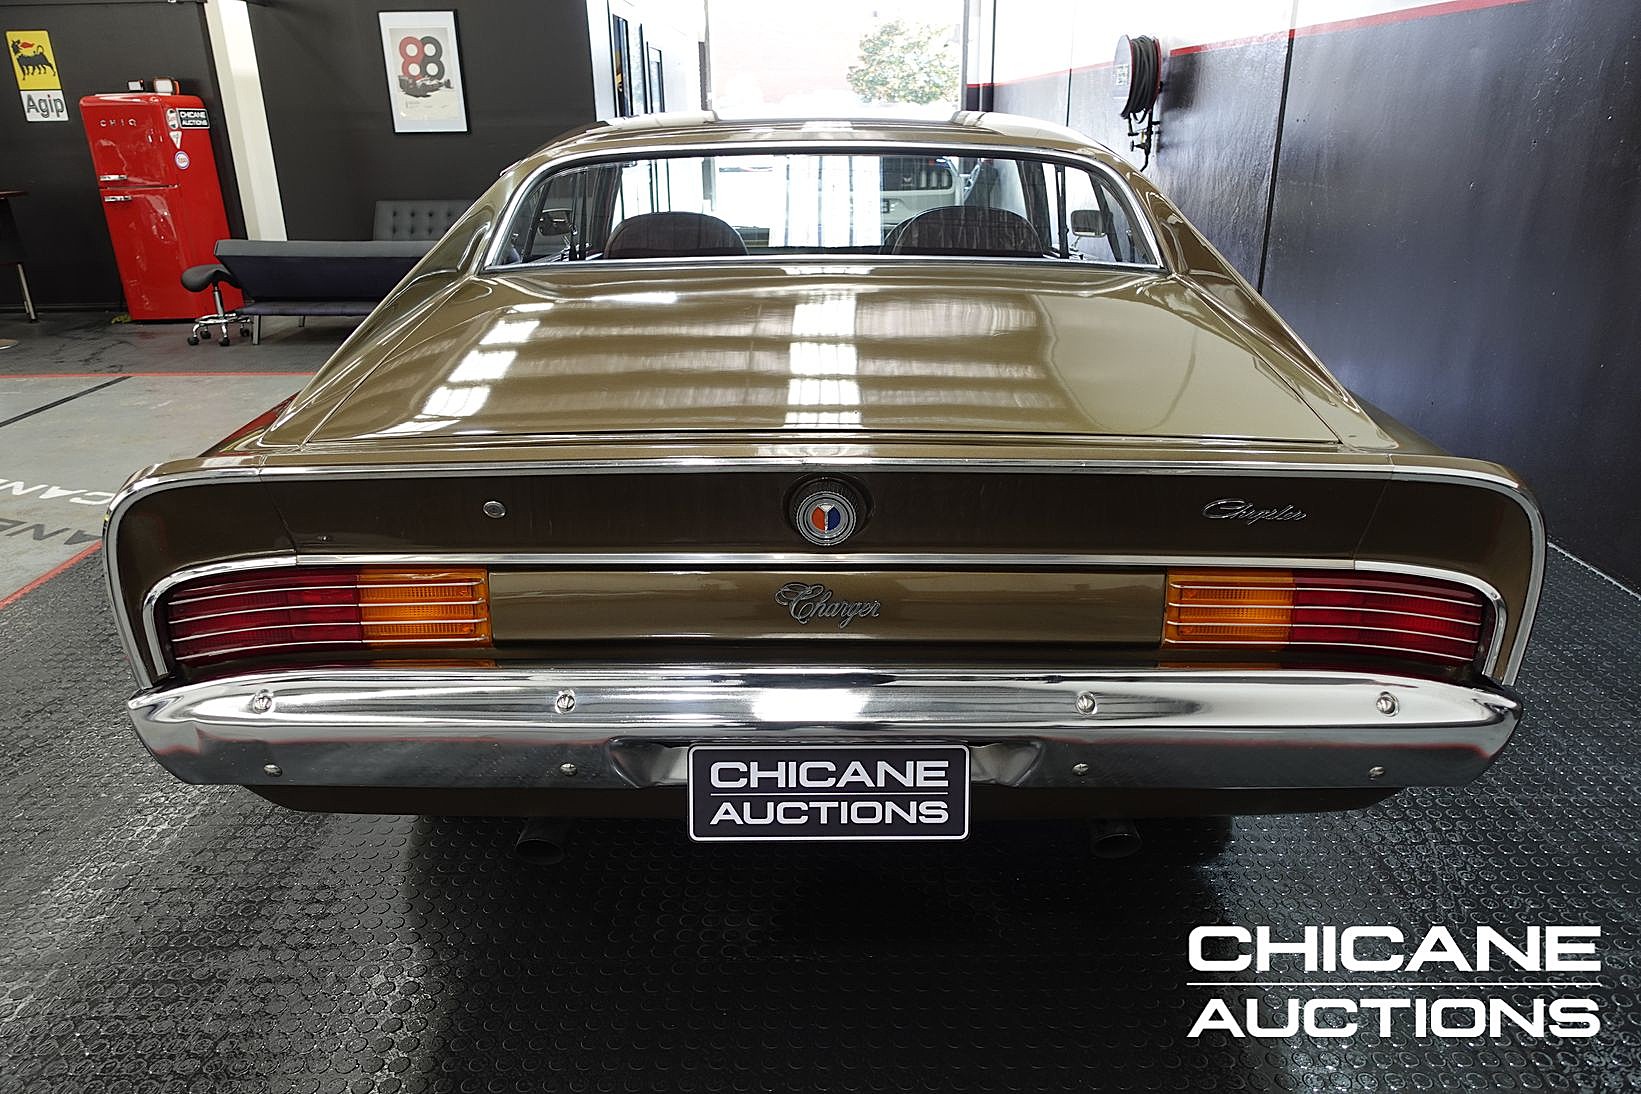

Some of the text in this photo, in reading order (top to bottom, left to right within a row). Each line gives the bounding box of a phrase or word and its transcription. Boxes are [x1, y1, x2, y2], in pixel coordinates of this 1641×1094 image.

[399, 36, 445, 81] 88
[27, 94, 65, 118] Agip
[180, 111, 206, 119] CHICANE
[0, 478, 116, 505] CAN
[1202, 498, 1307, 526] Chrysler
[774, 582, 882, 629] Charger
[710, 761, 949, 788] CHICANE
[709, 801, 949, 825] AUCTIONS
